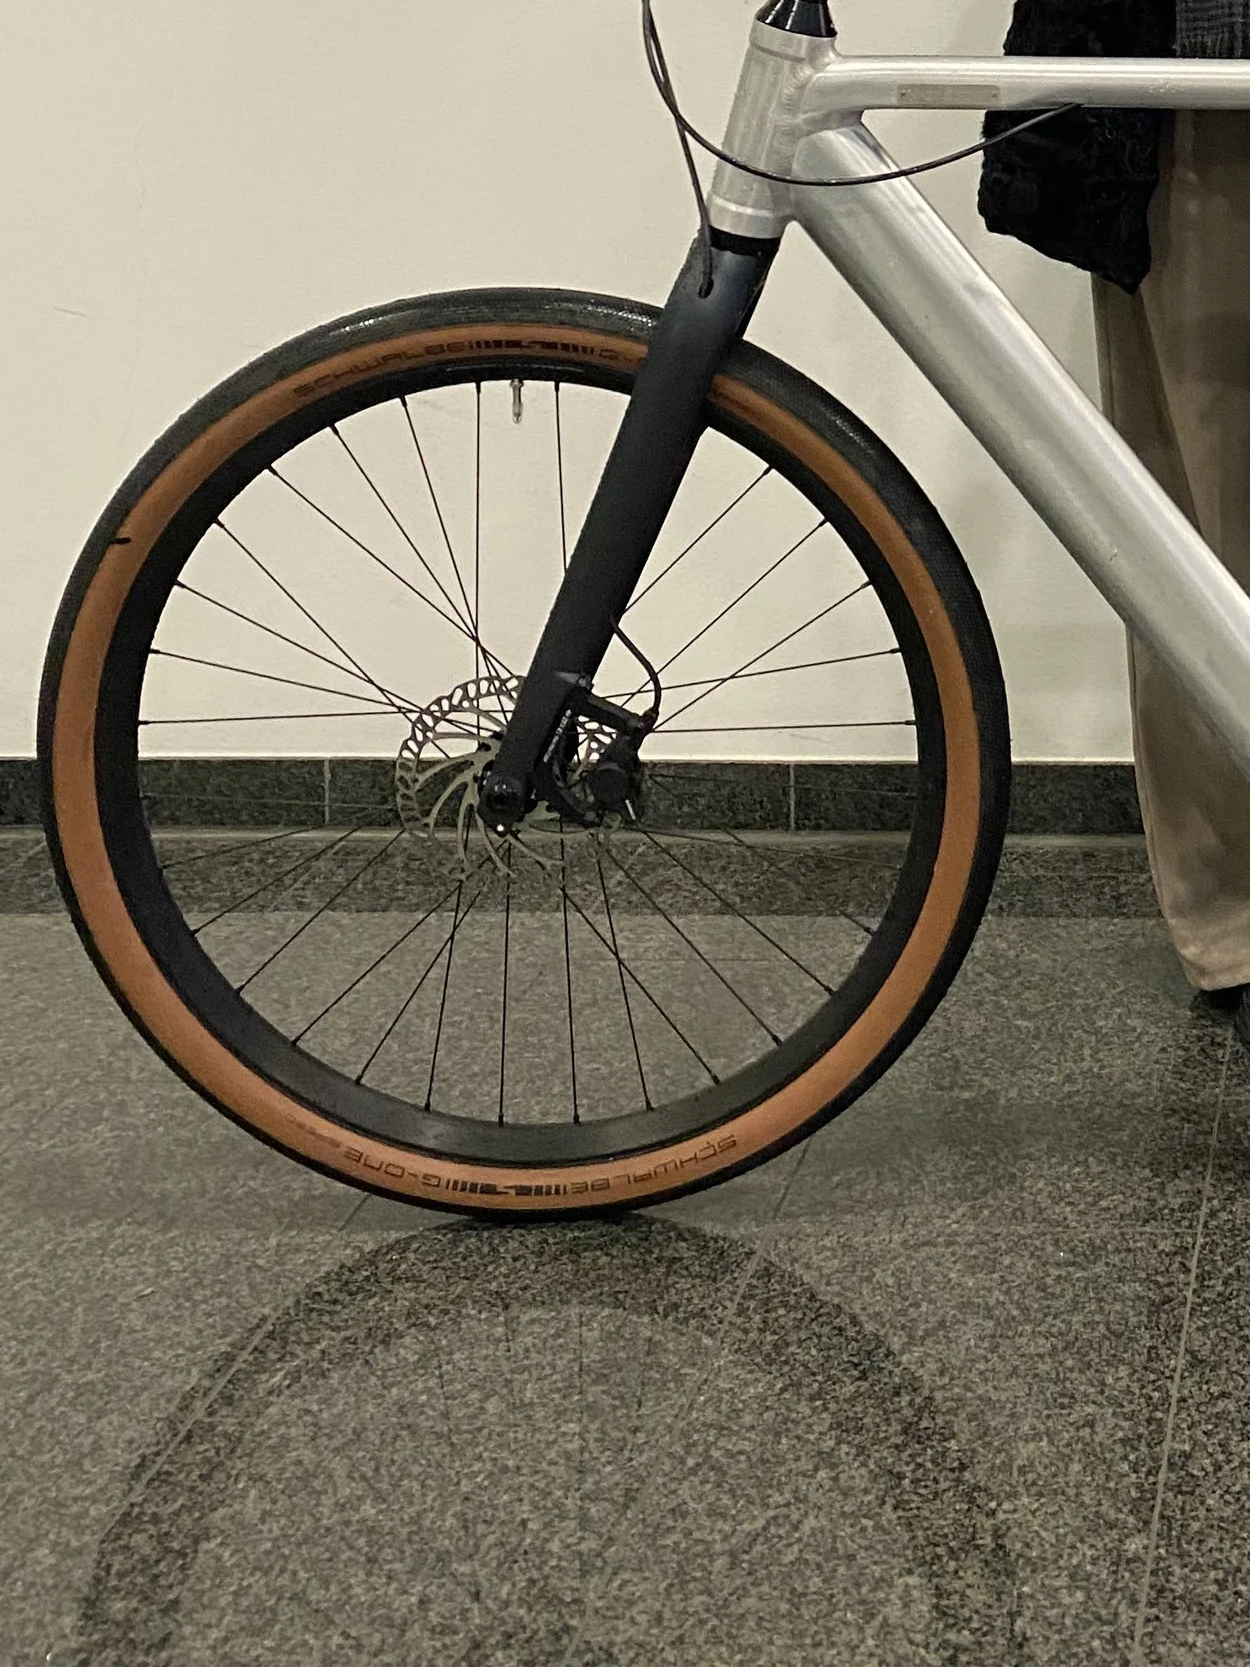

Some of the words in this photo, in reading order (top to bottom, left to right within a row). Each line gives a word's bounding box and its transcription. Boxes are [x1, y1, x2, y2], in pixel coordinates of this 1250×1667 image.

[294, 340, 464, 395] SCHWALBE
[344, 1145, 441, 1188] G-ONE
[571, 1134, 738, 1195] SCHWALBE
